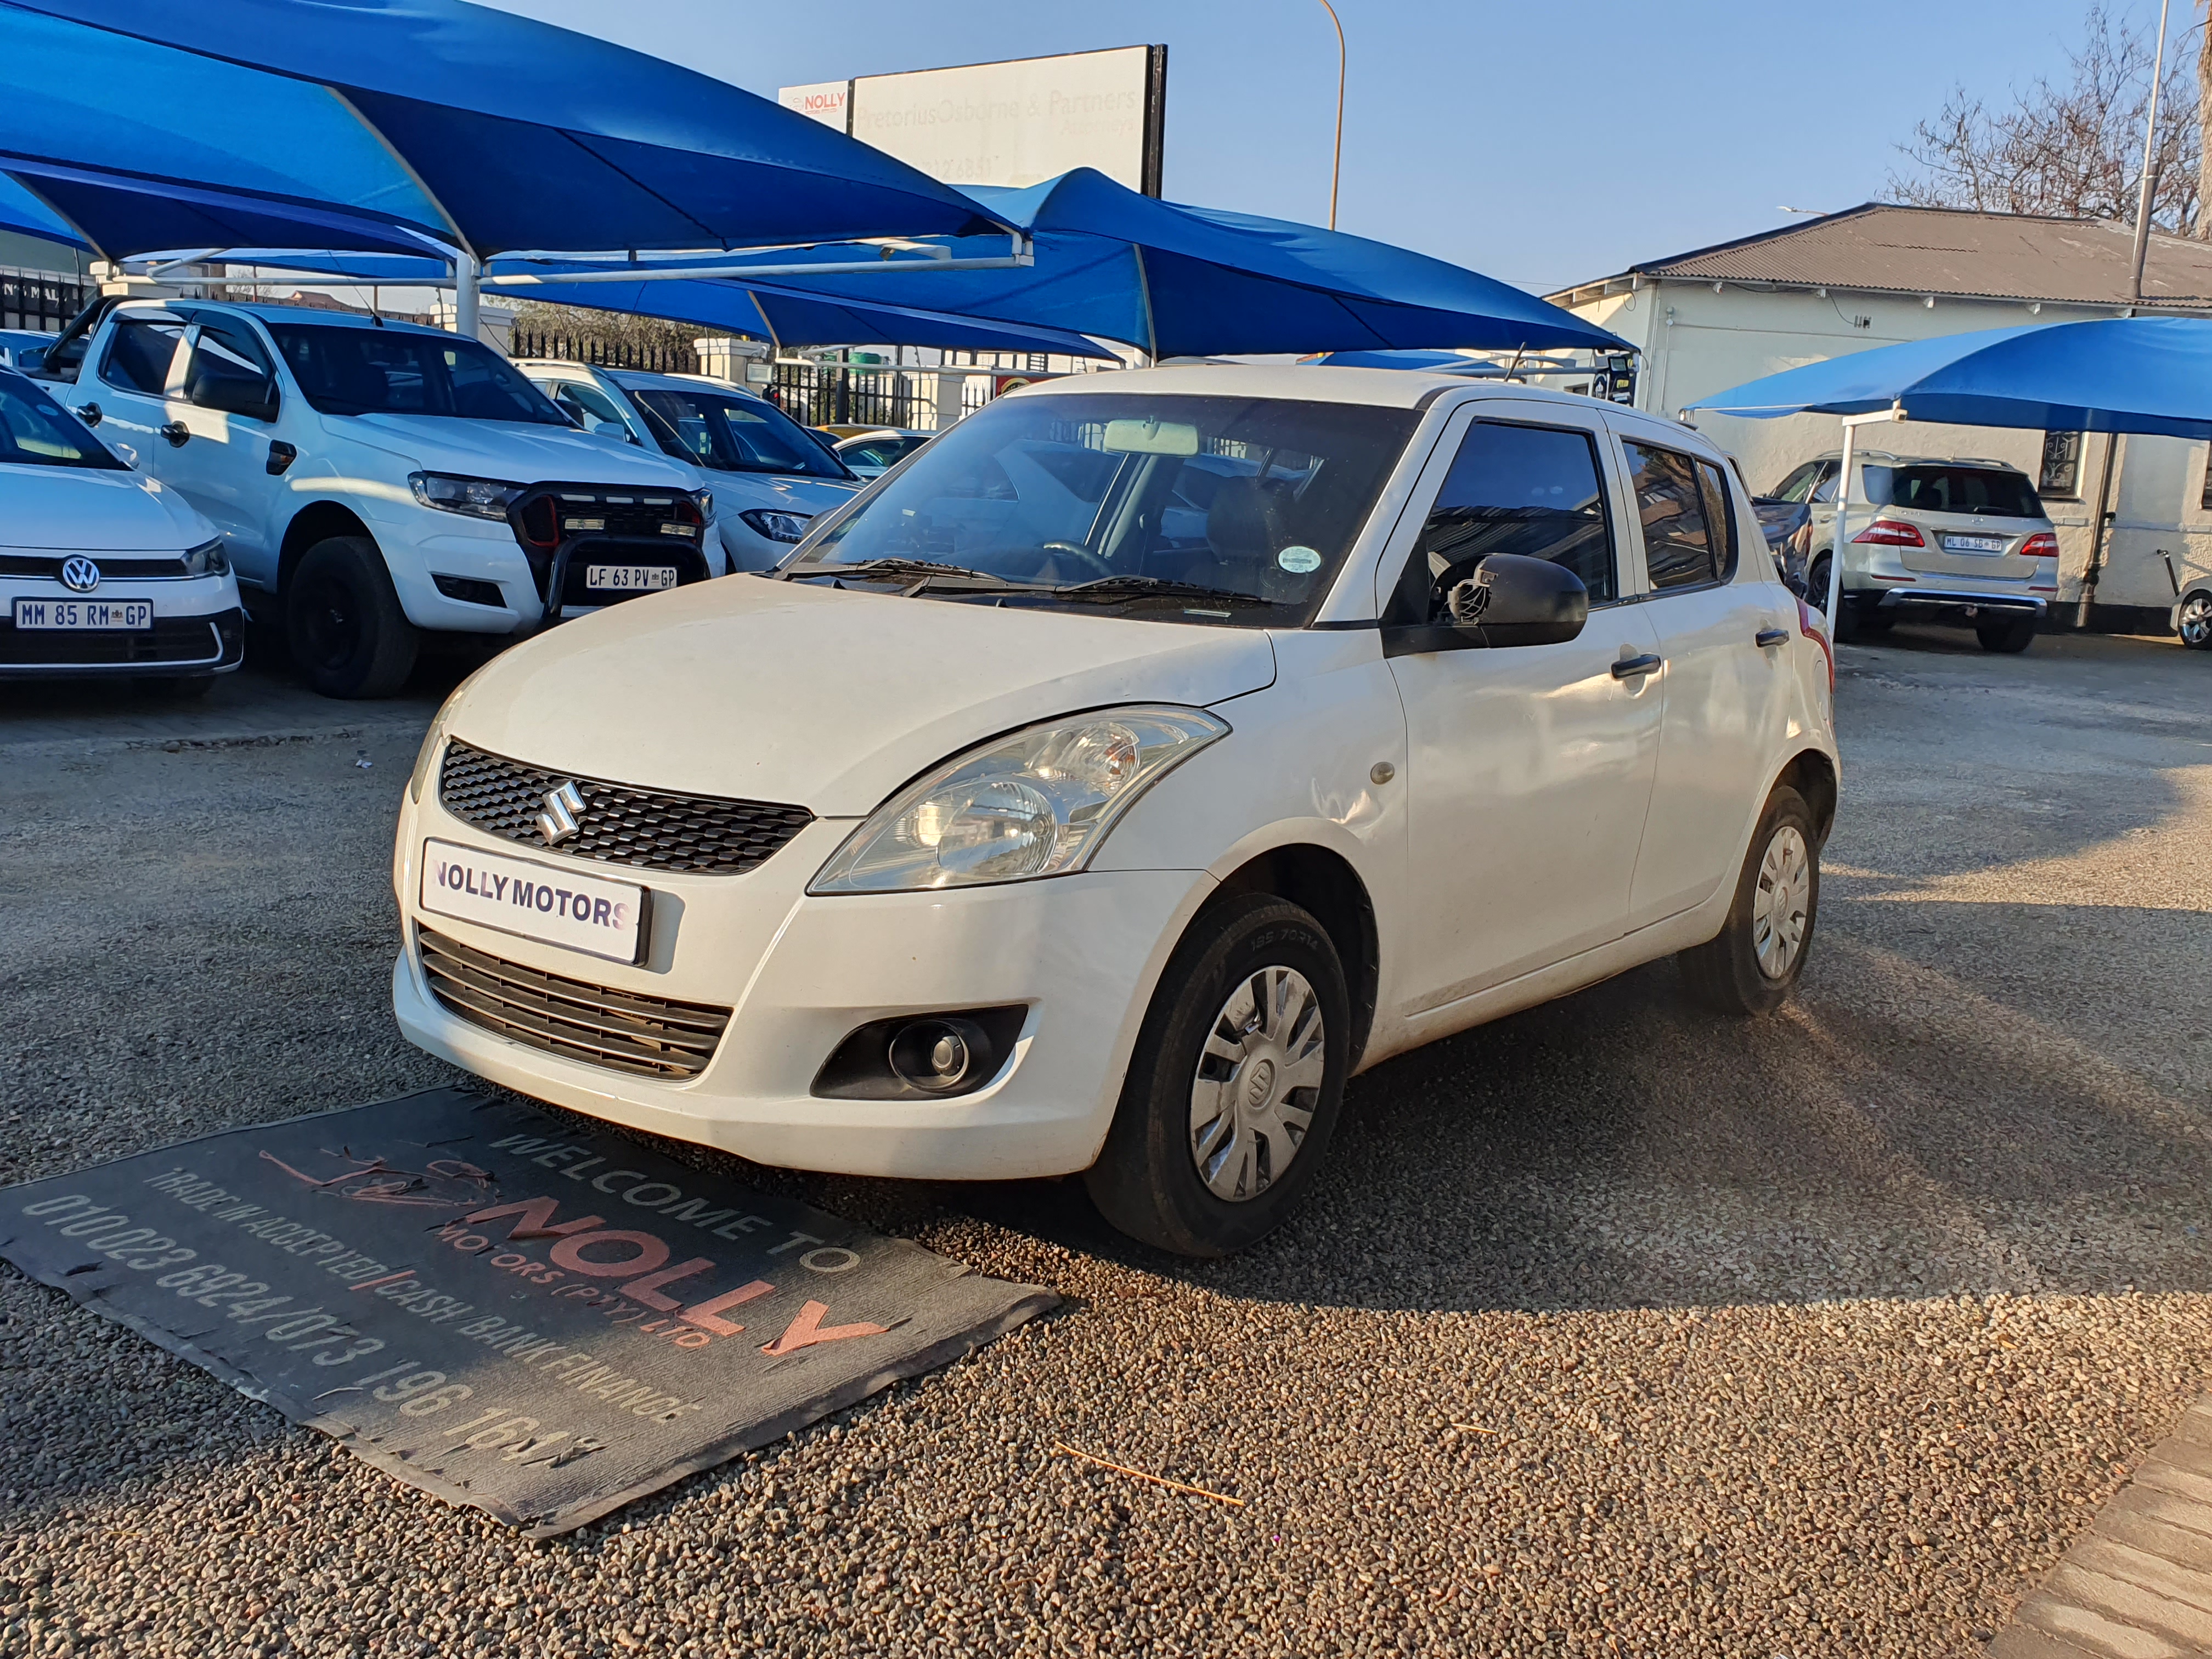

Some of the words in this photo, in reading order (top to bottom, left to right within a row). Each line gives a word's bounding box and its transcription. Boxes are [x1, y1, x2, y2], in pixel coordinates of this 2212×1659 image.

[805, 92, 845, 110] NOLLY
[1960, 538, 1970, 547] 06
[1991, 540, 2000, 549] GP
[590, 568, 607, 586] LF
[613, 568, 629, 586] 63
[634, 569, 649, 586] PV
[661, 570, 674, 587] GP
[22, 604, 45, 625] MM
[55, 605, 77, 625] 85
[87, 605, 109, 625] RM
[126, 605, 147, 627] GP
[432, 859, 509, 901] NOLLY
[512, 878, 630, 930] MOTORS
[489, 1133, 774, 1242] WELCOME
[766, 1231, 861, 1273] TO
[464, 1195, 890, 1357] NOLLY
